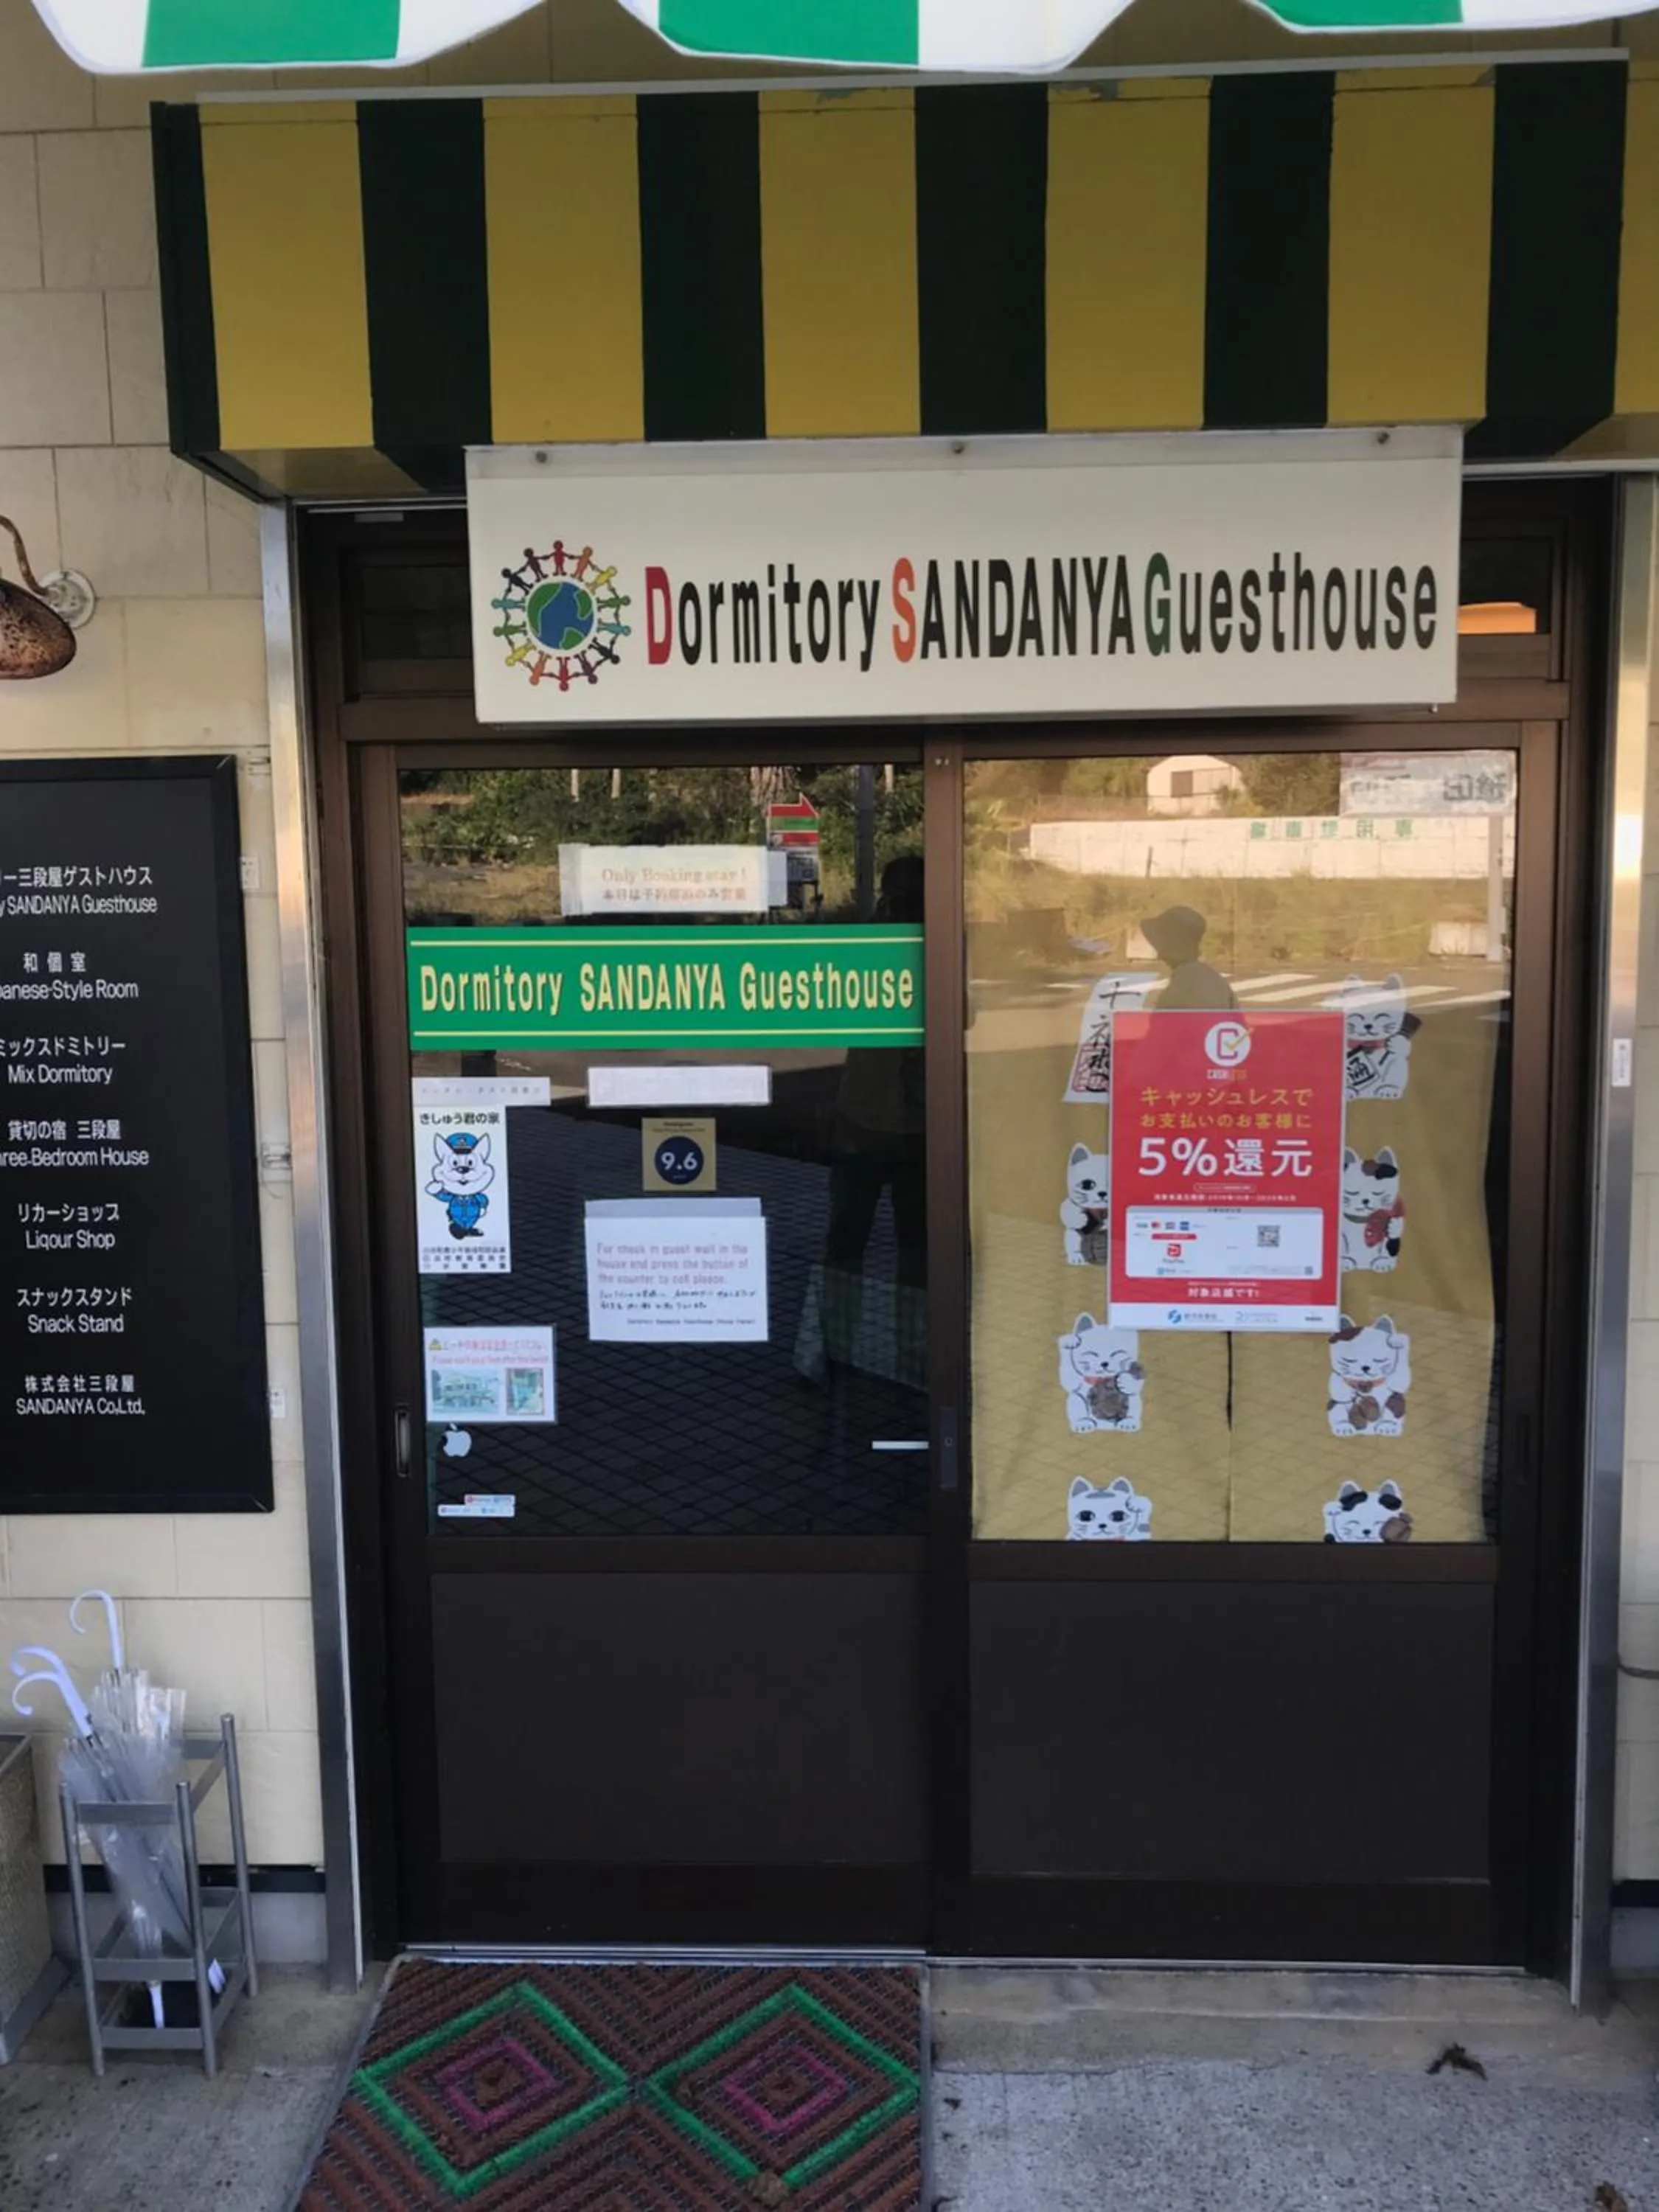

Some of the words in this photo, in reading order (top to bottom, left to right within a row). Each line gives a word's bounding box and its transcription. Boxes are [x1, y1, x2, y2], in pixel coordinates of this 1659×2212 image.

[645, 563, 880, 672] Dormitory
[892, 556, 1135, 662] SANDANYA
[1144, 552, 1437, 657] Guesthouse
[0, 866, 153, 888] ー三段屋ゲストハウス
[7, 894, 80, 915] SANDANYA
[82, 893, 158, 914] Guesthouse
[96, 978, 139, 998] Room
[420, 965, 563, 1015] Dormitory
[580, 963, 726, 1012] SANDANYA
[740, 962, 914, 1010] Guesthouse
[8, 1064, 35, 1083] Mix
[38, 1063, 113, 1085] Dormitory
[1141, 1087, 1314, 1107] キャッシュレスで
[8, 1119, 67, 1141] 貸切の宿
[1140, 1112, 1312, 1130] お支払いのお客様に
[100, 1147, 150, 1166] House
[661, 1152, 698, 1170] 9.6
[76, 1229, 116, 1250] Shop
[17, 1287, 133, 1307] スナックスタンド
[27, 1313, 76, 1333] Snack
[78, 1313, 125, 1333] Stand
[16, 1397, 95, 1415] SANDANYA
